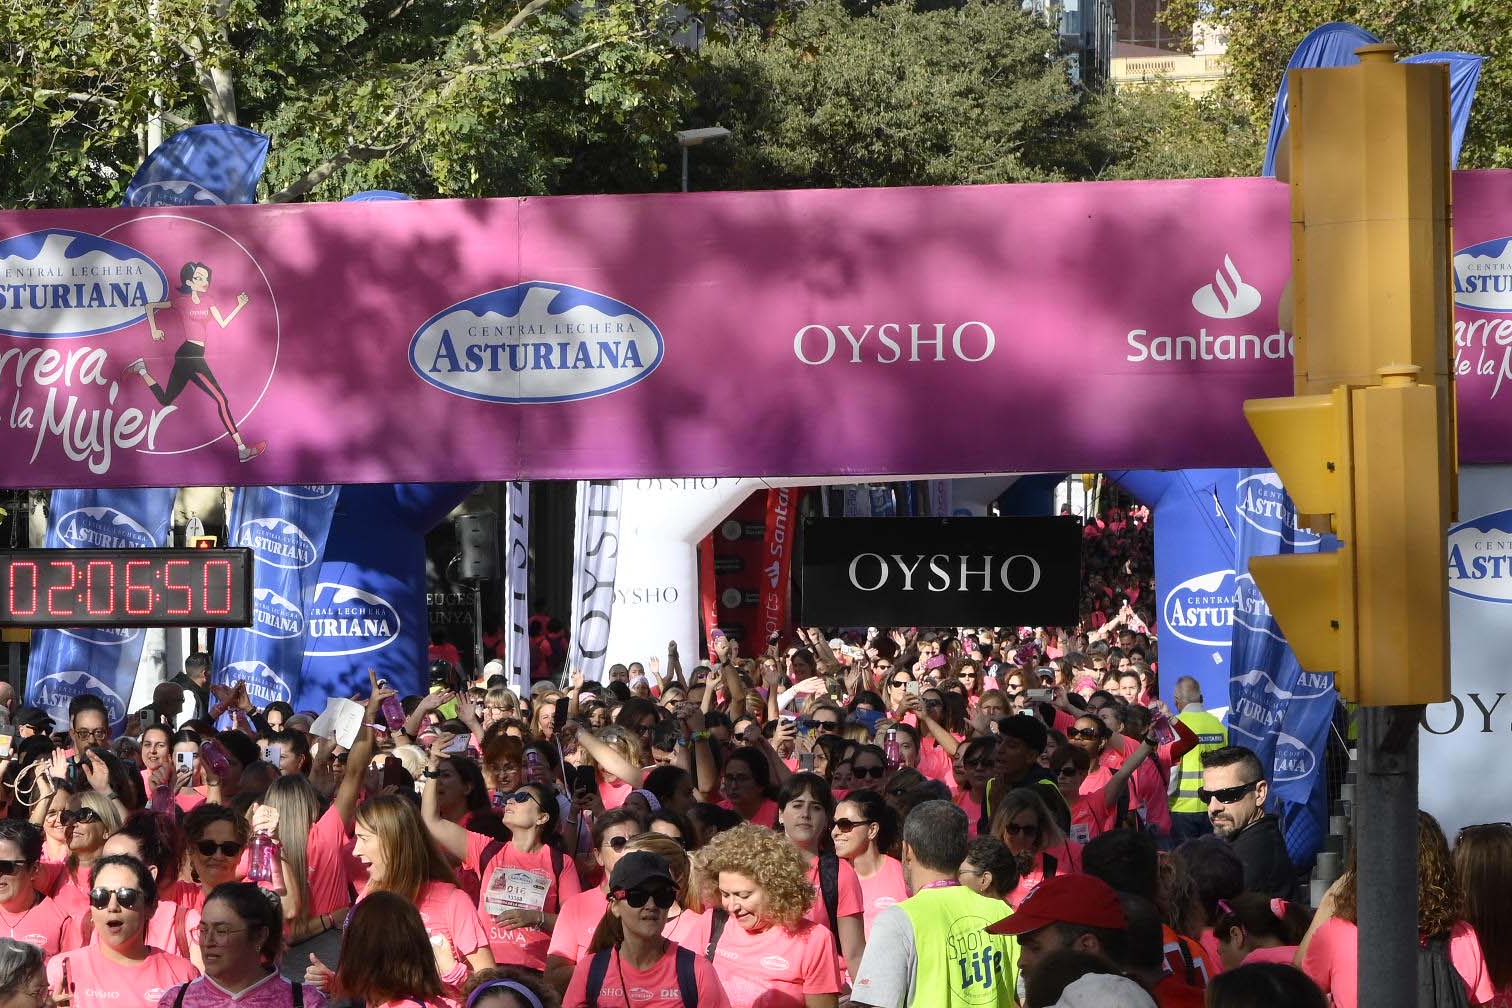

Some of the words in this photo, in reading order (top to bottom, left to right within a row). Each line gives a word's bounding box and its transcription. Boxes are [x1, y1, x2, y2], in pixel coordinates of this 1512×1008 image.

[72, 265, 144, 276] LECHERA
[468, 325, 545, 336] CENTRAL
[554, 323, 636, 335] LECHERA
[793, 321, 996, 365] OYSHO
[1126, 329, 1296, 363] Santand
[428, 329, 644, 374] ASTURIANA
[10, 387, 34, 430] la
[29, 382, 179, 475] Mujer
[240, 533, 309, 564] ASTURIANA
[9, 560, 232, 616] 02:06:50
[848, 552, 1042, 594] OYSHO
[1419, 692, 1512, 735] OY
[959, 945, 1003, 990] Life
